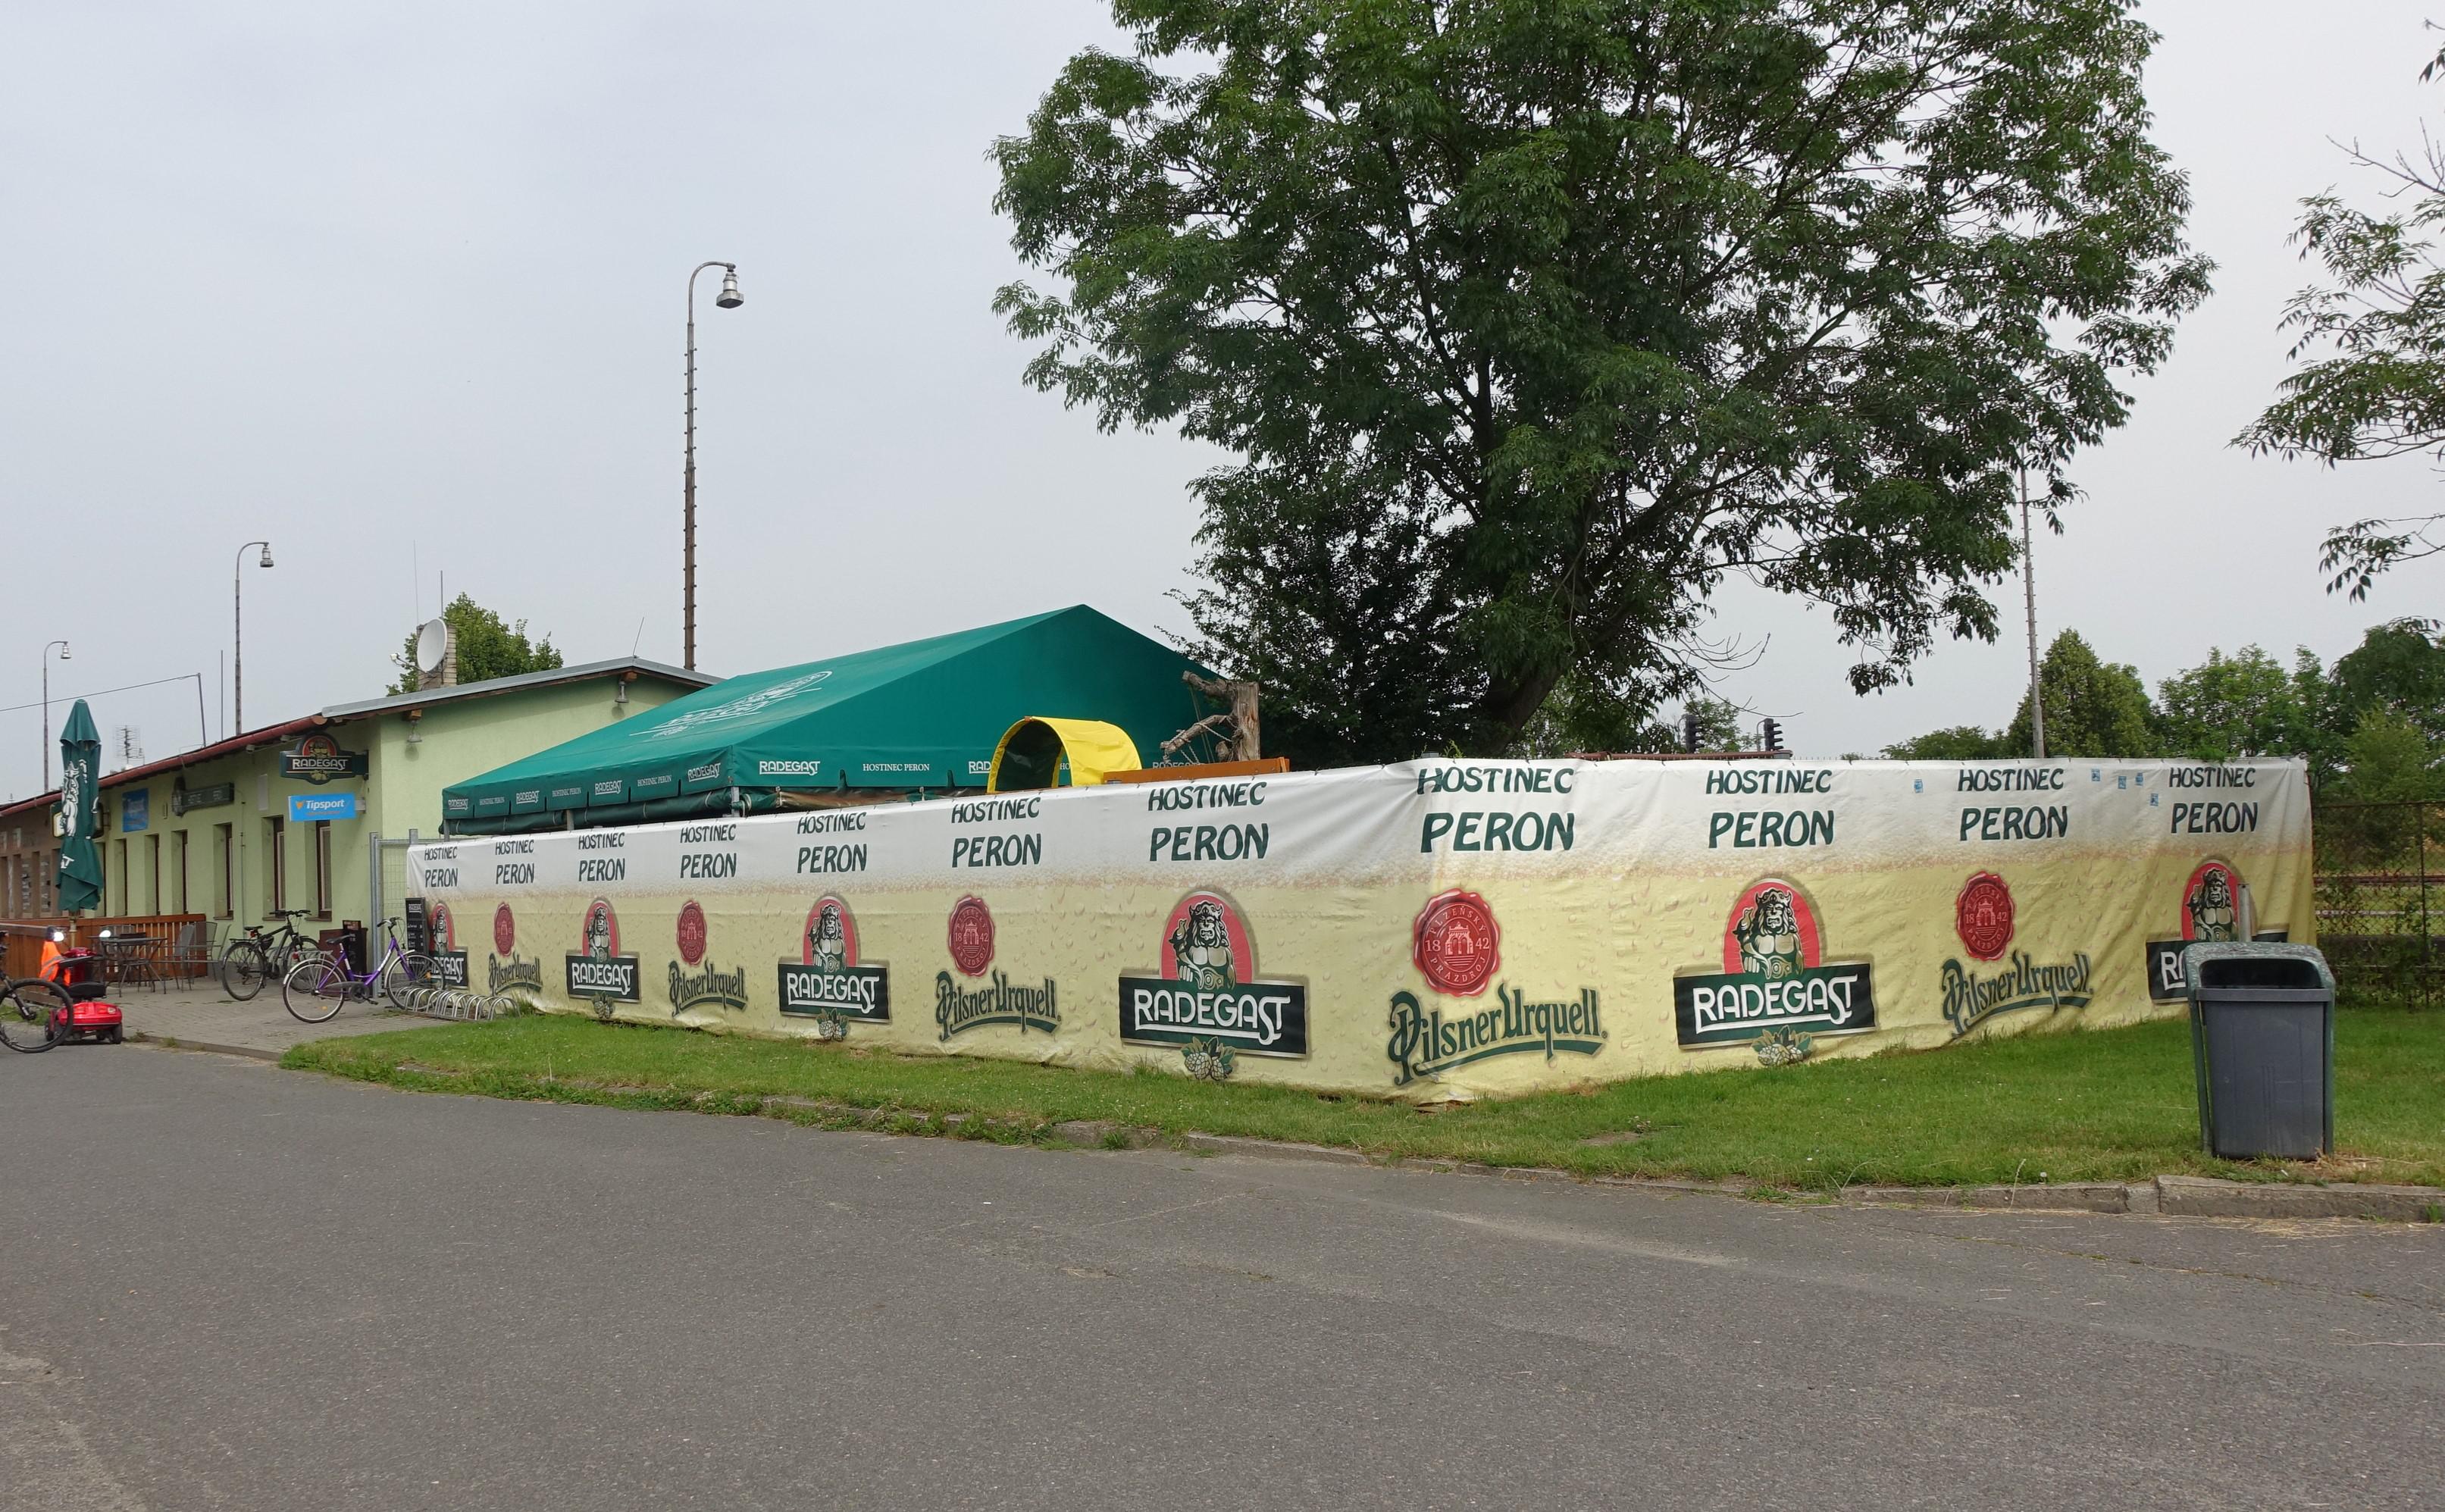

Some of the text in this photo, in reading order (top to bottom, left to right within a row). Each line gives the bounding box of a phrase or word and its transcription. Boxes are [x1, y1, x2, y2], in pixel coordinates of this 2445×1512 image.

[293, 759, 349, 771] RADEGAST
[687, 762, 721, 782] RADEGAST
[759, 760, 820, 776] RADEGAST
[862, 763, 930, 772] HOSTINEC PERON
[637, 775, 672, 787] HOSTINEC PERON
[1417, 766, 1574, 794] HOSTINEC
[1705, 769, 1833, 794] HOSTINEC
[1958, 768, 2064, 792] HOSTINEC
[2169, 766, 2255, 787] HOSTINEC
[516, 790, 540, 804] RADEGAST
[595, 781, 622, 795] RADEGAST
[1148, 781, 1266, 811] HOSTINEC
[306, 799, 345, 811] Tipsport
[951, 797, 1041, 824] HOSTINEC
[797, 812, 866, 834] HOSTINEC
[1709, 810, 1834, 848] PERON
[1961, 806, 2068, 841] PERON
[2171, 803, 2258, 833] PERON
[578, 831, 625, 850] HOSTINEC
[680, 824, 736, 844] HOSTINEC
[1150, 824, 1269, 861] PERON
[1421, 812, 1574, 853] PERON
[424, 846, 457, 861] HOSTINEC
[496, 839, 534, 856] HOSTINEC
[797, 844, 866, 873] PERON
[952, 834, 1041, 868] PERON
[496, 864, 534, 884] PERON
[579, 859, 625, 881] PERON
[681, 853, 736, 878] PERON
[425, 869, 458, 887] PERON
[1965, 912, 2008, 924] 18 42
[955, 933, 989, 942] 18 42
[1425, 938, 1490, 952] 18 42
[571, 964, 634, 995] RADEGAST
[1430, 956, 1486, 983] PRAZDROJ
[787, 972, 879, 1014] RADEGAST
[1135, 988, 1291, 1043] RADEGAST
[1693, 975, 1858, 1034] RADEGAST
